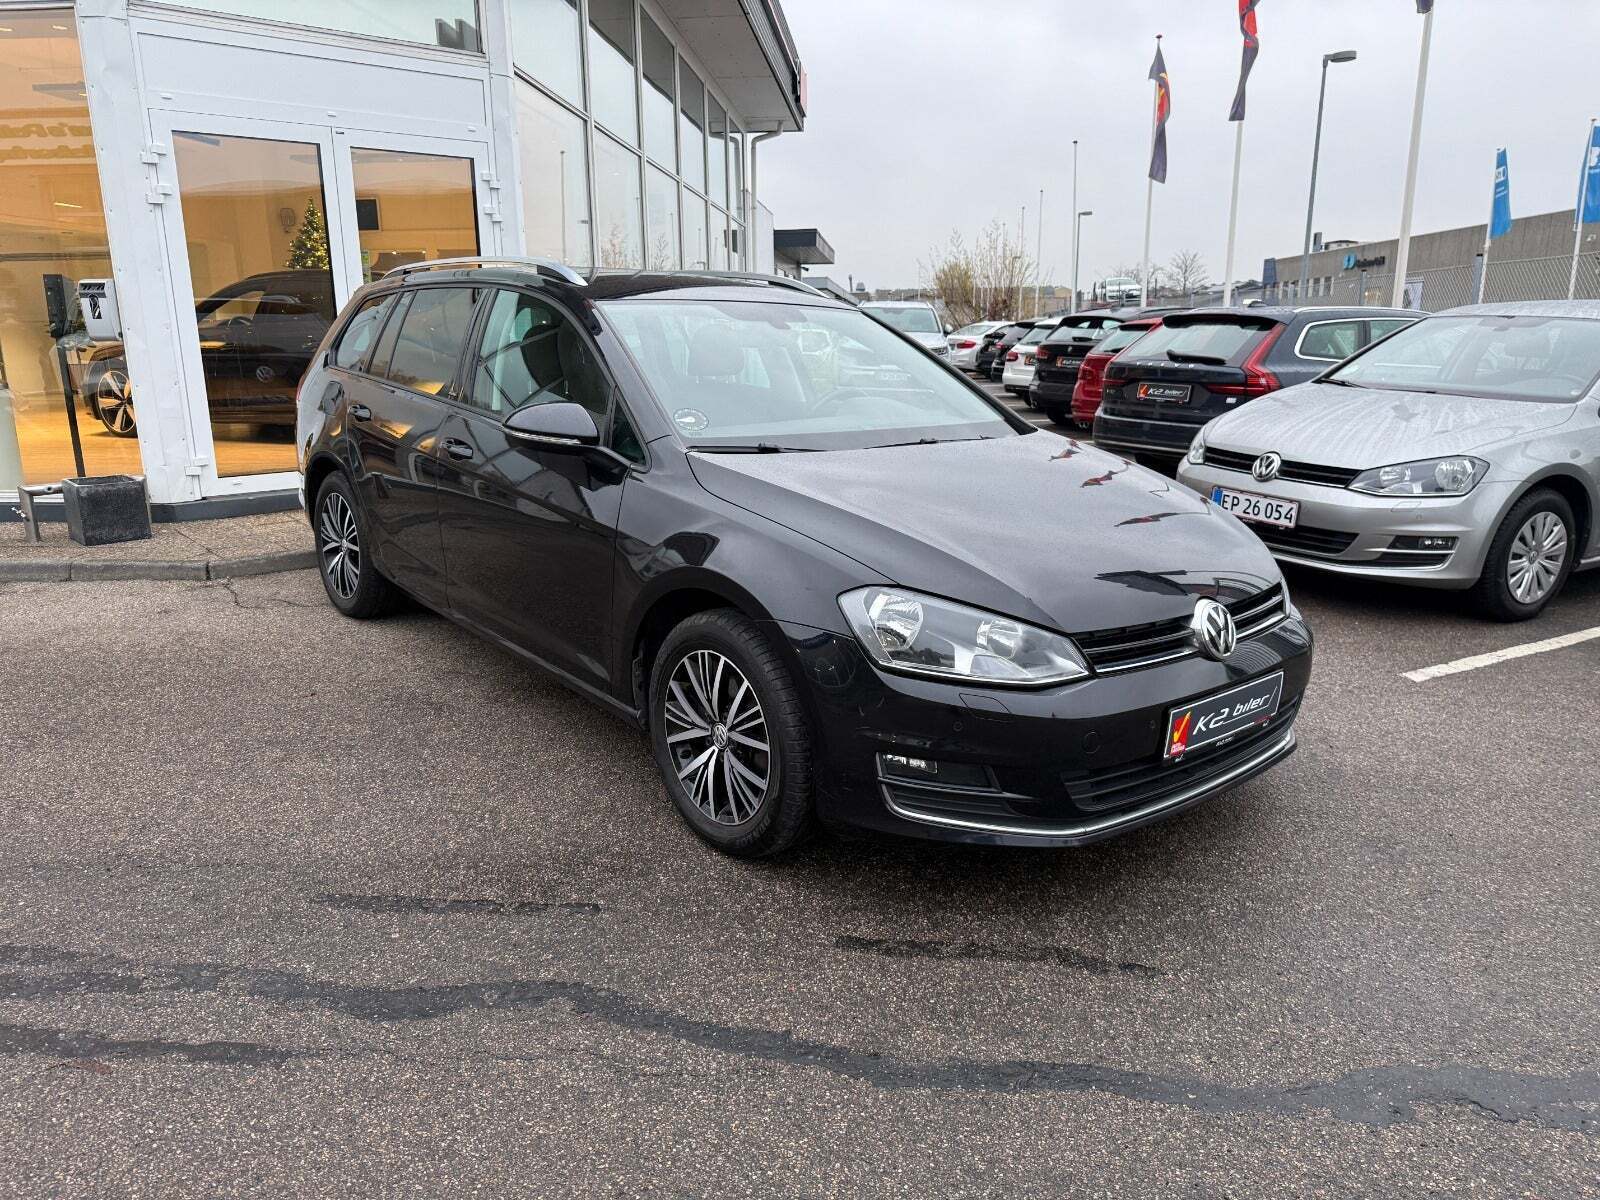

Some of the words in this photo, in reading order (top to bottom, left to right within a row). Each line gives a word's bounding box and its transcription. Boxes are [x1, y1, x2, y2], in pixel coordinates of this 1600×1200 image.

[1147, 387, 1164, 396] K2
[1221, 494, 1240, 512] EP
[1243, 499, 1261, 516] 26
[1264, 502, 1294, 524] 054
[1192, 707, 1230, 735] K2
[1232, 693, 1270, 717] biler
